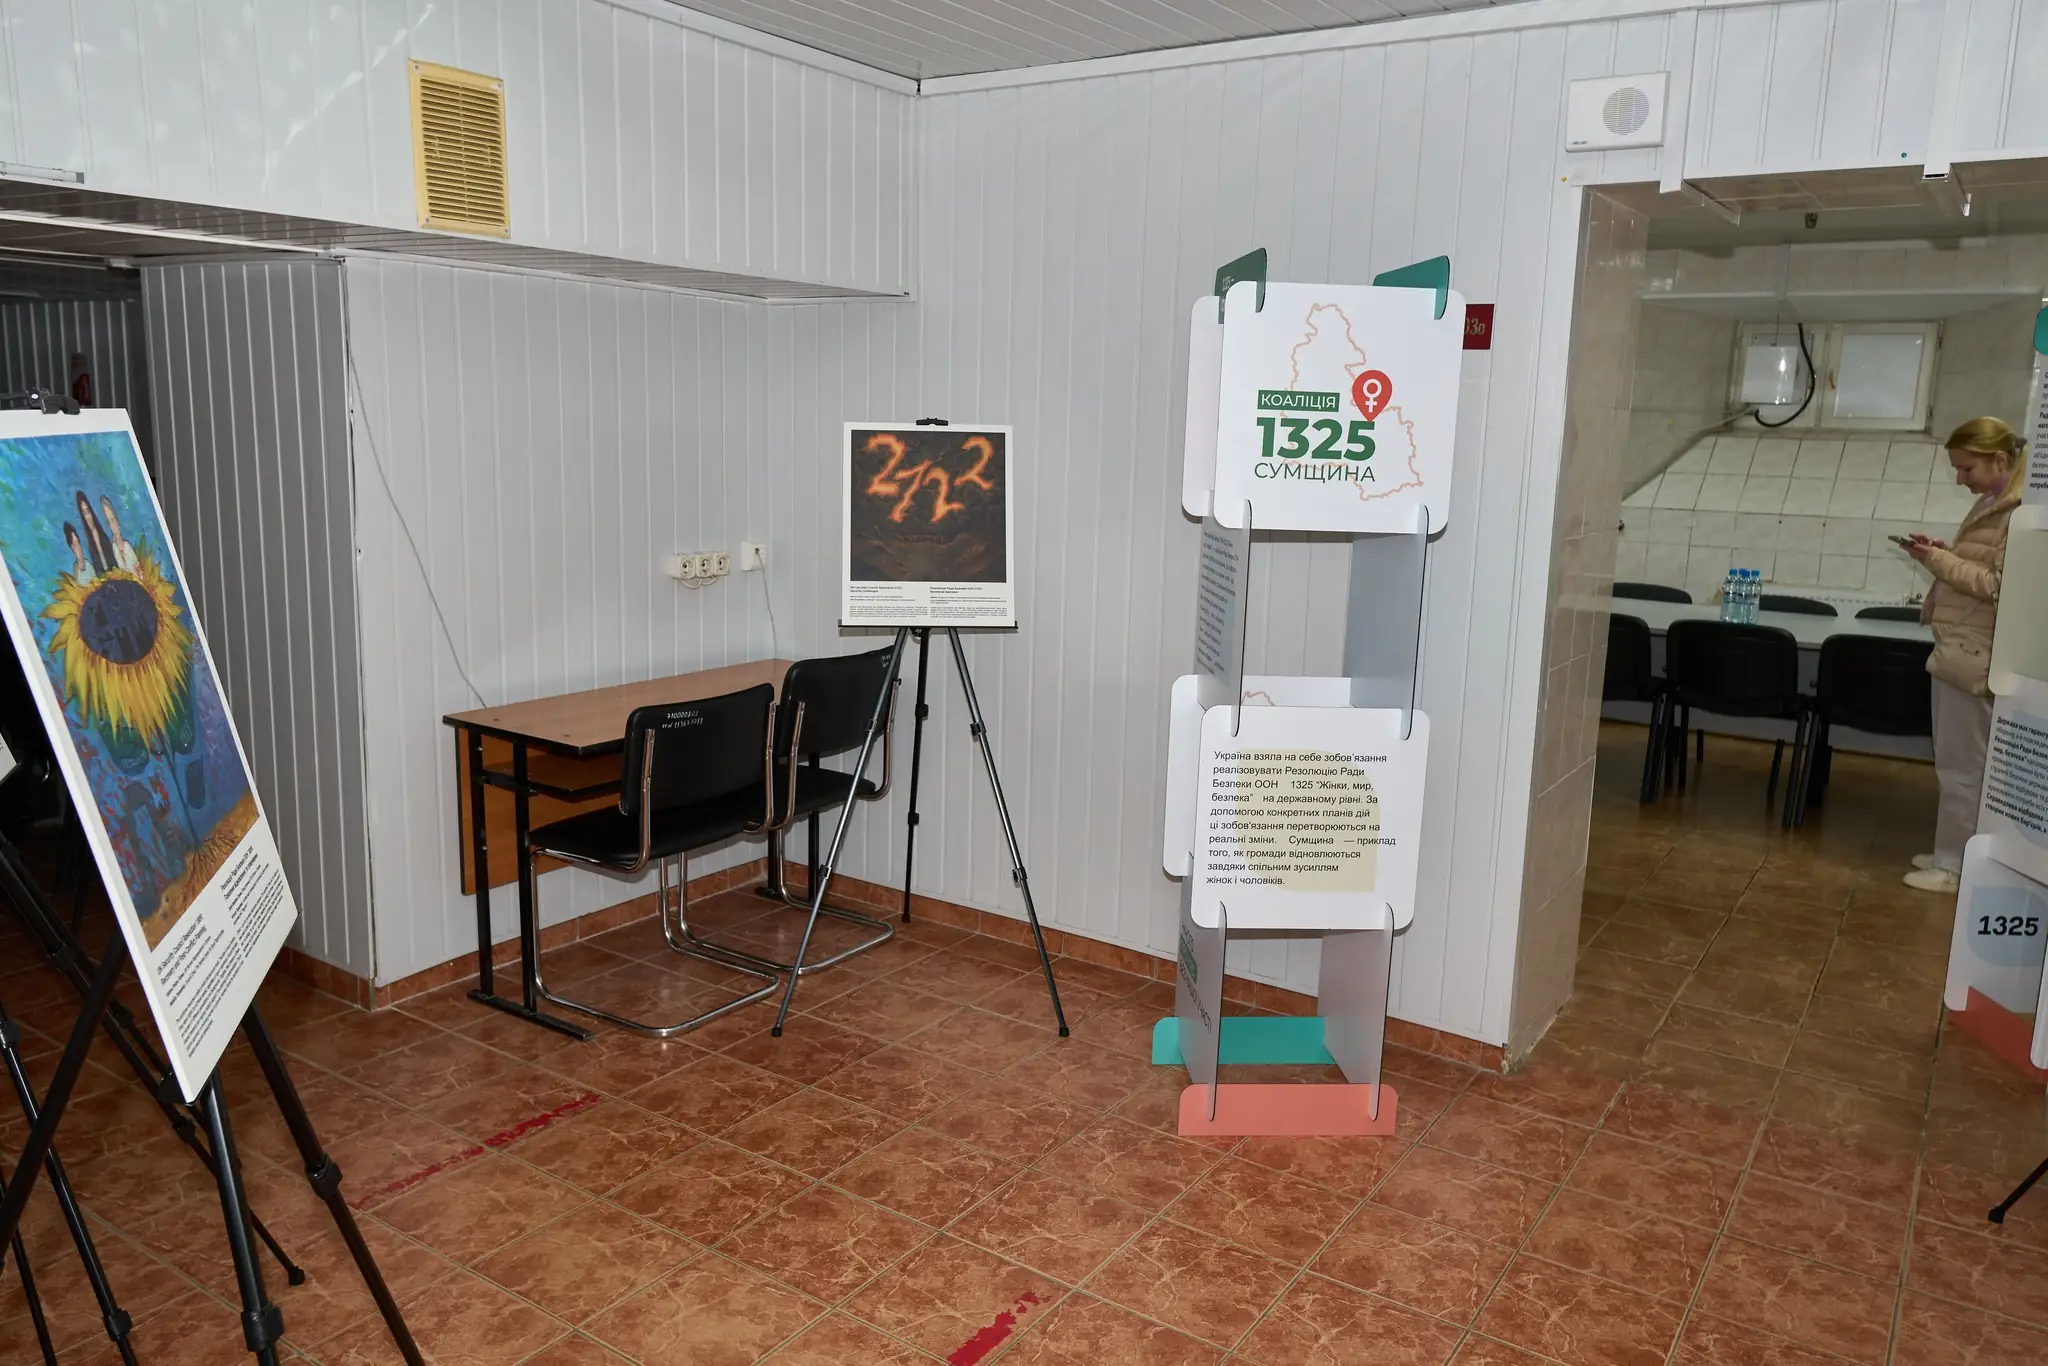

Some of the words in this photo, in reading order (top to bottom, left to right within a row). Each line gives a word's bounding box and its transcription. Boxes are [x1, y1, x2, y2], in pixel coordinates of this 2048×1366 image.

[1261, 393, 1336, 410] КОАЛІЦІЯ
[1256, 416, 1376, 462] 1325
[1254, 462, 1376, 483] СУМЩИНА
[1214, 750, 1251, 762] Україна
[1254, 753, 1282, 761] взяла
[1284, 753, 1296, 762] на
[1298, 752, 1322, 762] себе
[1213, 766, 1282, 776] реалізовувати
[1284, 766, 1338, 776] Резолюцію
[1340, 766, 1365, 777] Ради
[1212, 778, 1252, 788] Безпеки
[1254, 779, 1278, 789] ООН
[1291, 780, 1314, 790] 1325
[1352, 782, 1374, 792] мир,
[1262, 794, 1274, 802] на
[1276, 796, 1337, 806] державному
[1338, 794, 1363, 805] рівні.
[1366, 794, 1378, 804] За
[1210, 807, 1264, 816] допомогою
[1266, 808, 1320, 818] конкретних
[1322, 808, 1354, 818] планів
[1355, 808, 1370, 818] дій
[1210, 820, 1218, 830] ці
[1286, 822, 1366, 832] перетворюються
[1368, 823, 1380, 832] на
[1208, 834, 1246, 844] реальні
[1248, 834, 1277, 844] зміни.
[1288, 835, 1334, 846] Сумщина
[1357, 837, 1396, 846] приклад
[1208, 849, 1230, 858] того,
[1233, 849, 1244, 857] як
[1246, 849, 1286, 859] громади
[1288, 849, 1361, 859] відновлюються
[1207, 862, 1246, 872] завдяки
[1248, 861, 1291, 871] спільним
[1293, 864, 1339, 874] зусиллям
[1206, 875, 1232, 884] жінок
[1239, 875, 1285, 885] чоловіків.
[1978, 915, 2039, 937] 1325
